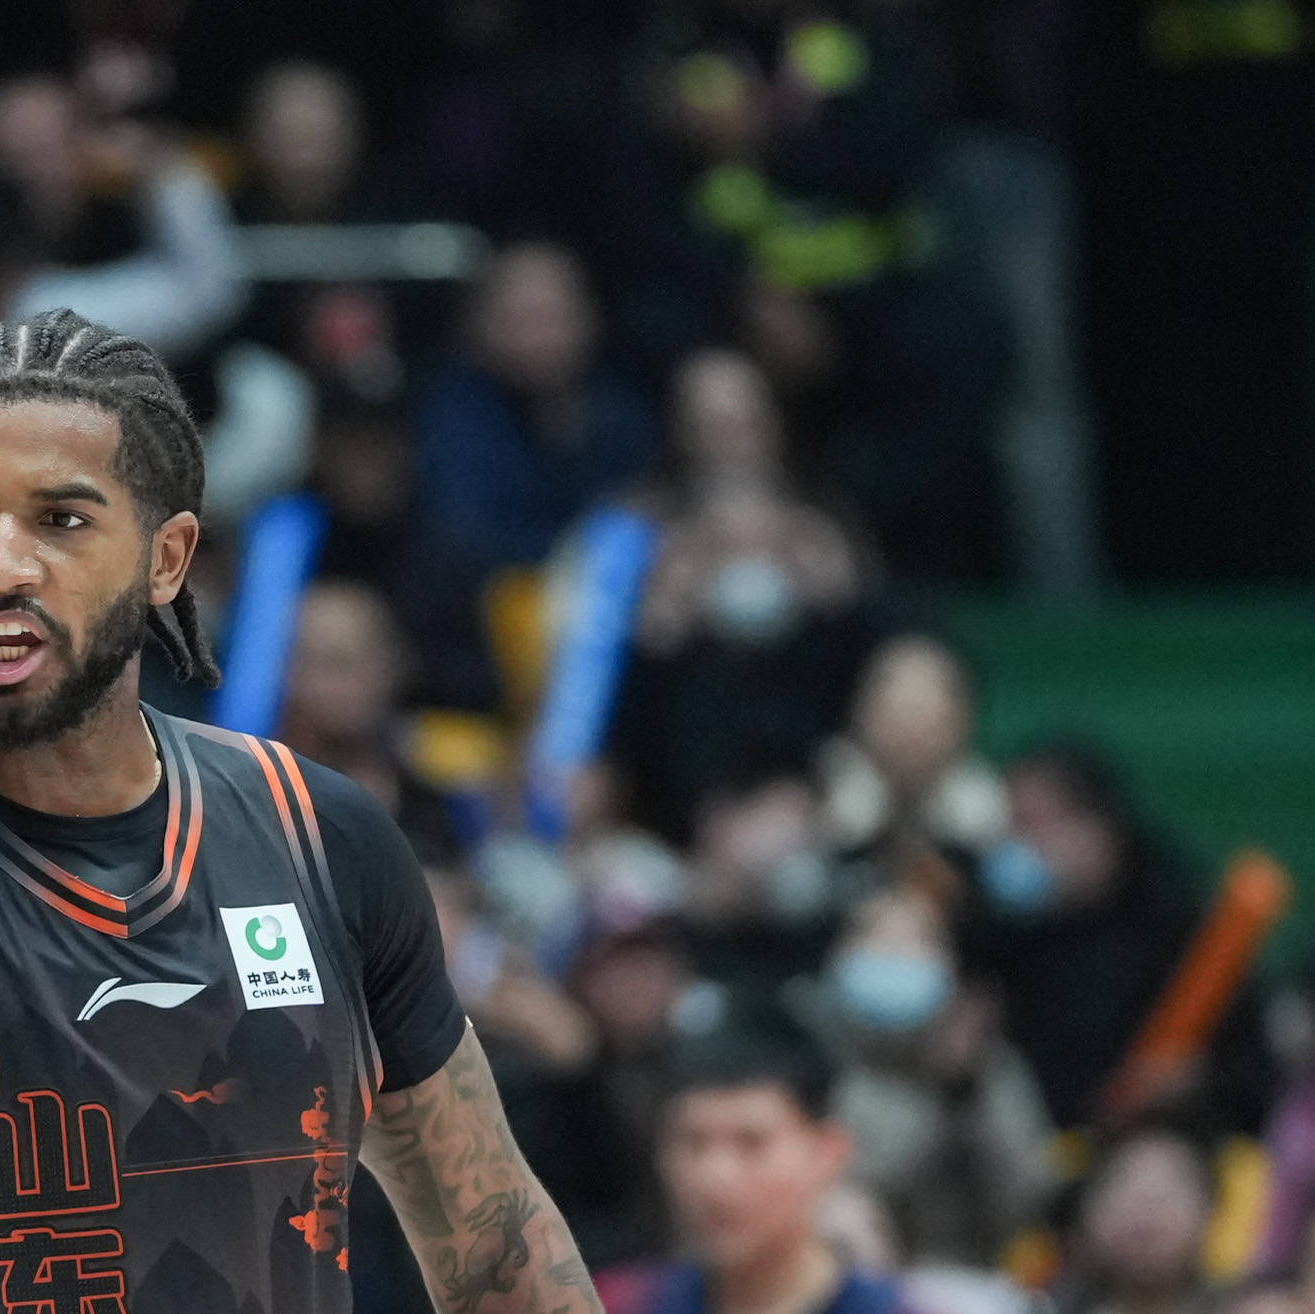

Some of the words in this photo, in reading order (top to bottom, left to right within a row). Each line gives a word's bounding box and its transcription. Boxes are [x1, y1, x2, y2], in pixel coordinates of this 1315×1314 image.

[247, 968, 311, 987] 中国人寿
[252, 987, 289, 999] CHINA
[291, 984, 315, 995] LIFE
